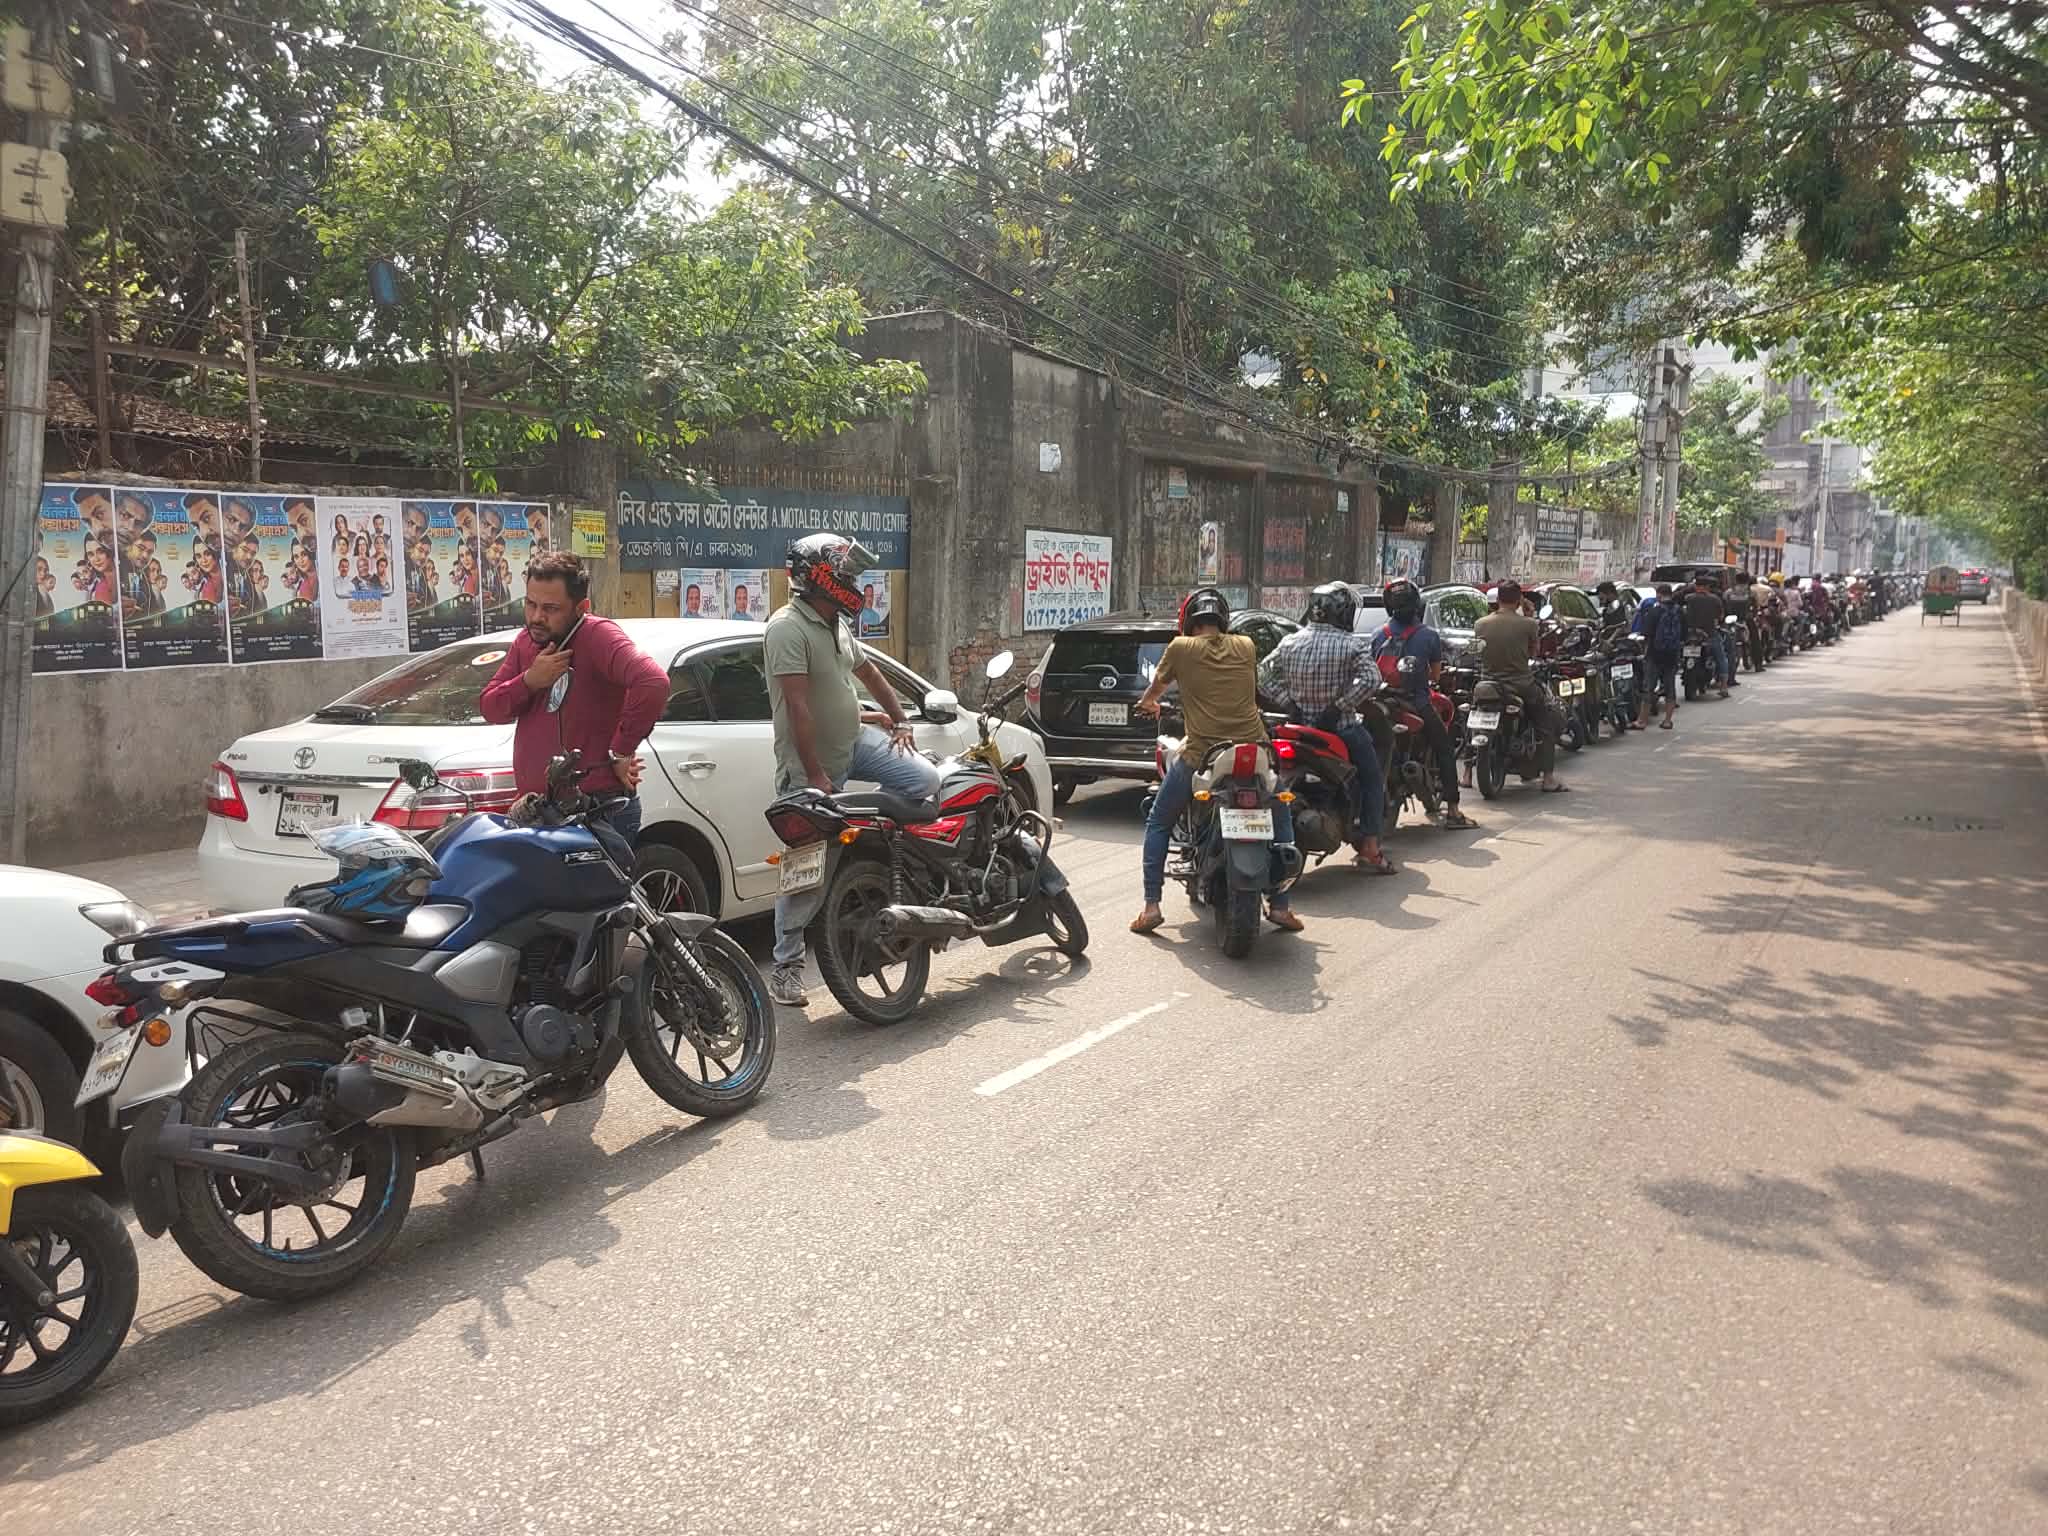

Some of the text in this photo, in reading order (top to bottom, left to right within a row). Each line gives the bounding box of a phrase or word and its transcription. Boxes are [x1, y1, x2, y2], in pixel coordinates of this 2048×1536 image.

[703, 499, 732, 529] অটো
[733, 498, 768, 530] সেন্টার
[822, 509, 830, 530] &
[832, 510, 859, 532] SONS
[860, 511, 881, 532] AUTO
[1026, 551, 1110, 591] ড্রাইভিং শিখুন
[284, 803, 301, 814] ঢাকা
[674, 937, 707, 980] YAMAHA
